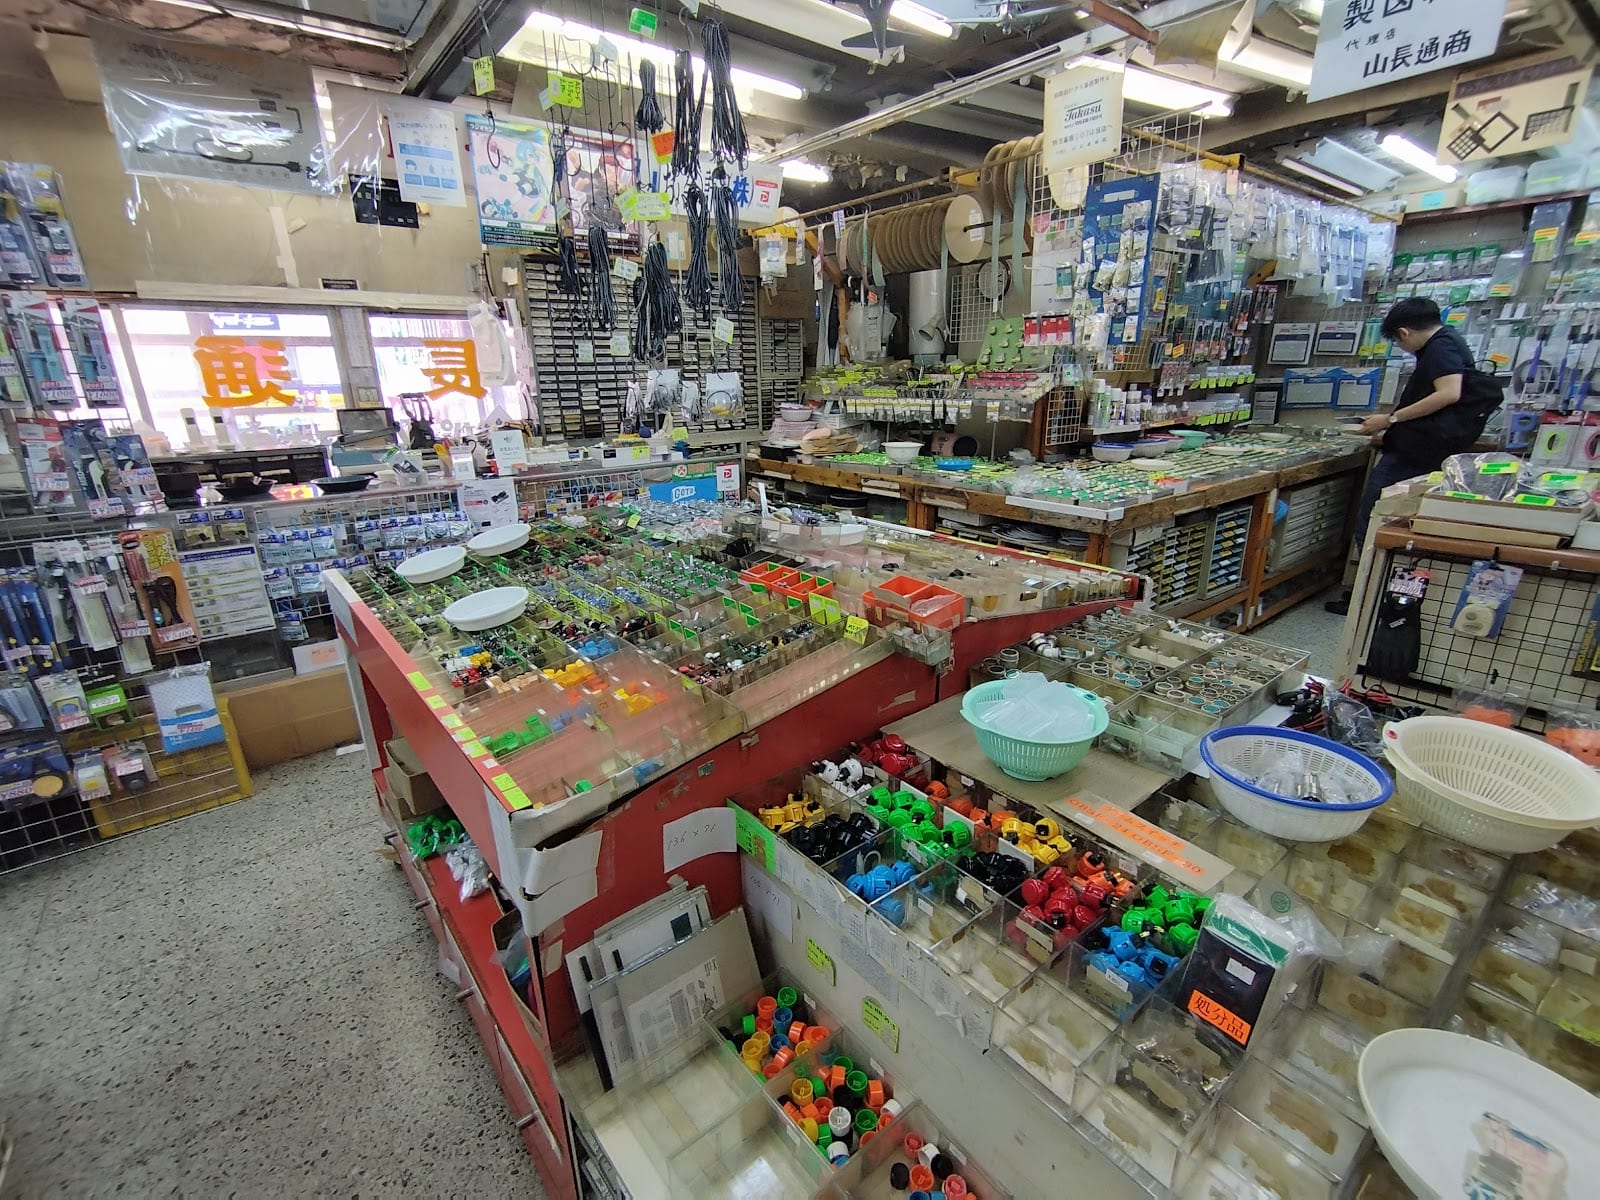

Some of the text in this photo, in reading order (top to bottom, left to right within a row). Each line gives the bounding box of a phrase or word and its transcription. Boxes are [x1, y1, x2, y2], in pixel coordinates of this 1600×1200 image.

[1345, 28, 1396, 52] 代理店
[1362, 29, 1473, 79] 山長通商
[1194, 995, 1247, 1041] 処分品
